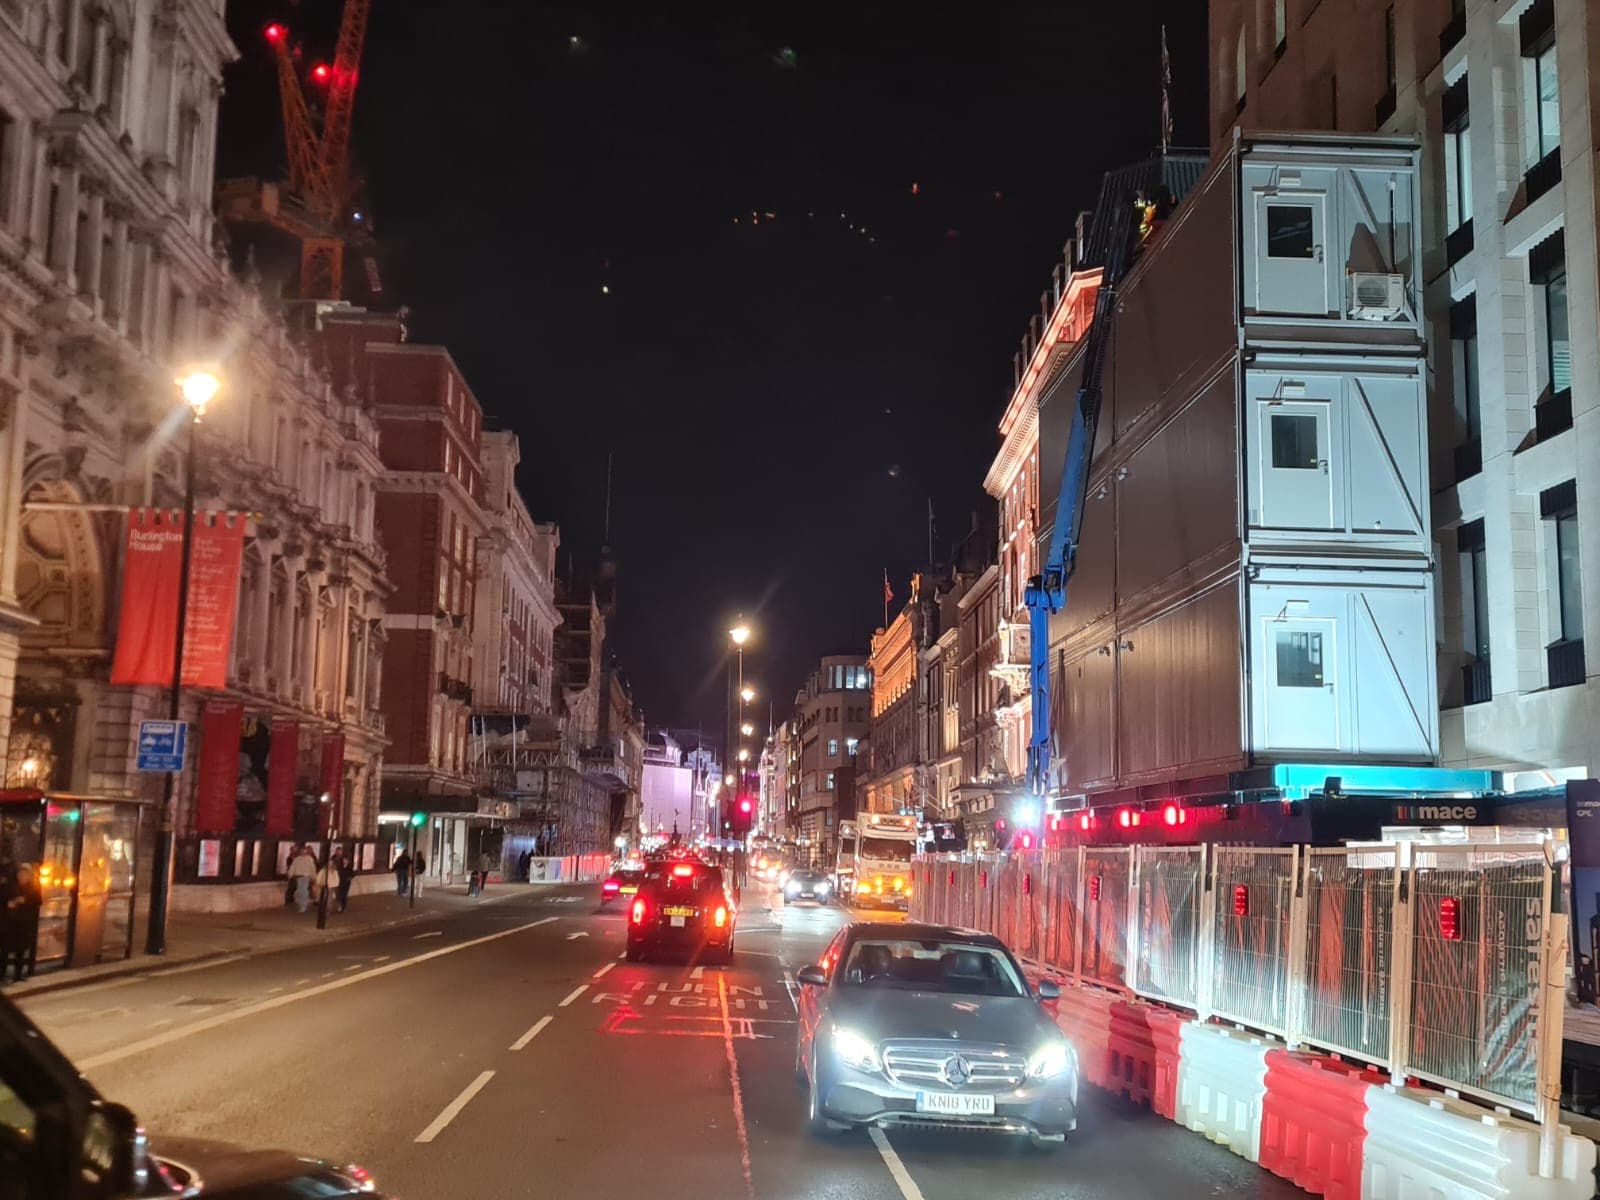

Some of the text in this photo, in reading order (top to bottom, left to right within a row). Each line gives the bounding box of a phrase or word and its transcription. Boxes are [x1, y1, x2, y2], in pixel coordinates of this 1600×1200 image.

[130, 528, 183, 542] Burlington
[129, 541, 162, 551] House
[1418, 805, 1477, 820] mace
[1498, 909, 1506, 982] ACOUSTIC
[625, 980, 763, 996] TURN
[592, 992, 779, 1010] RIGHT
